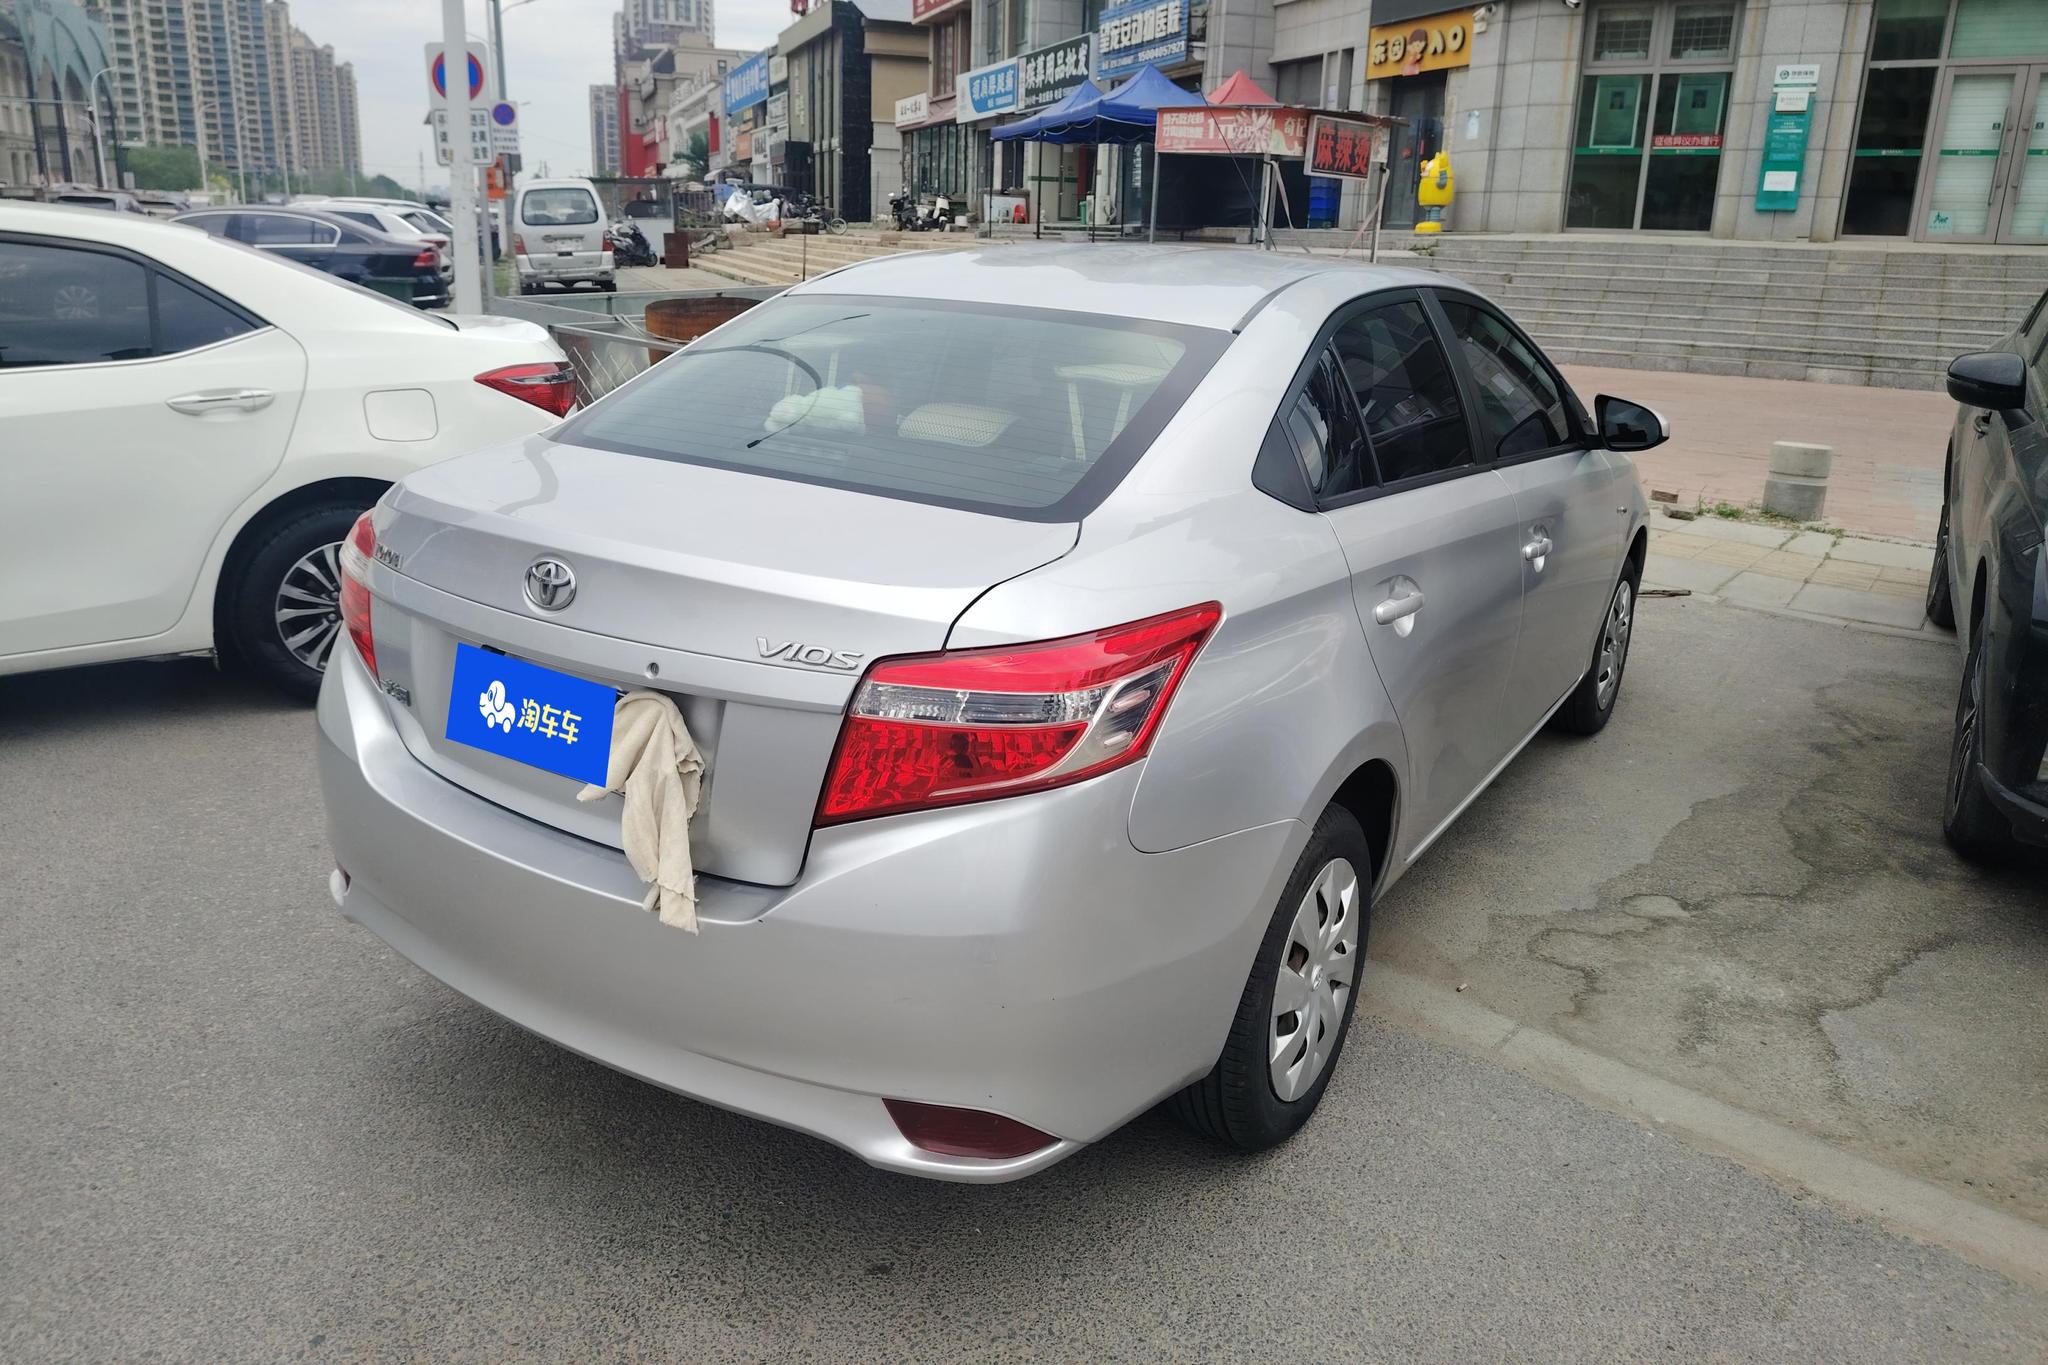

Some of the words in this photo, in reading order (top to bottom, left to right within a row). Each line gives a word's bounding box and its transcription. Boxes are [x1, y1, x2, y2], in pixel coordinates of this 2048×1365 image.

[1314, 124, 1369, 174] 麻辣烫
[756, 636, 864, 671] VIOS
